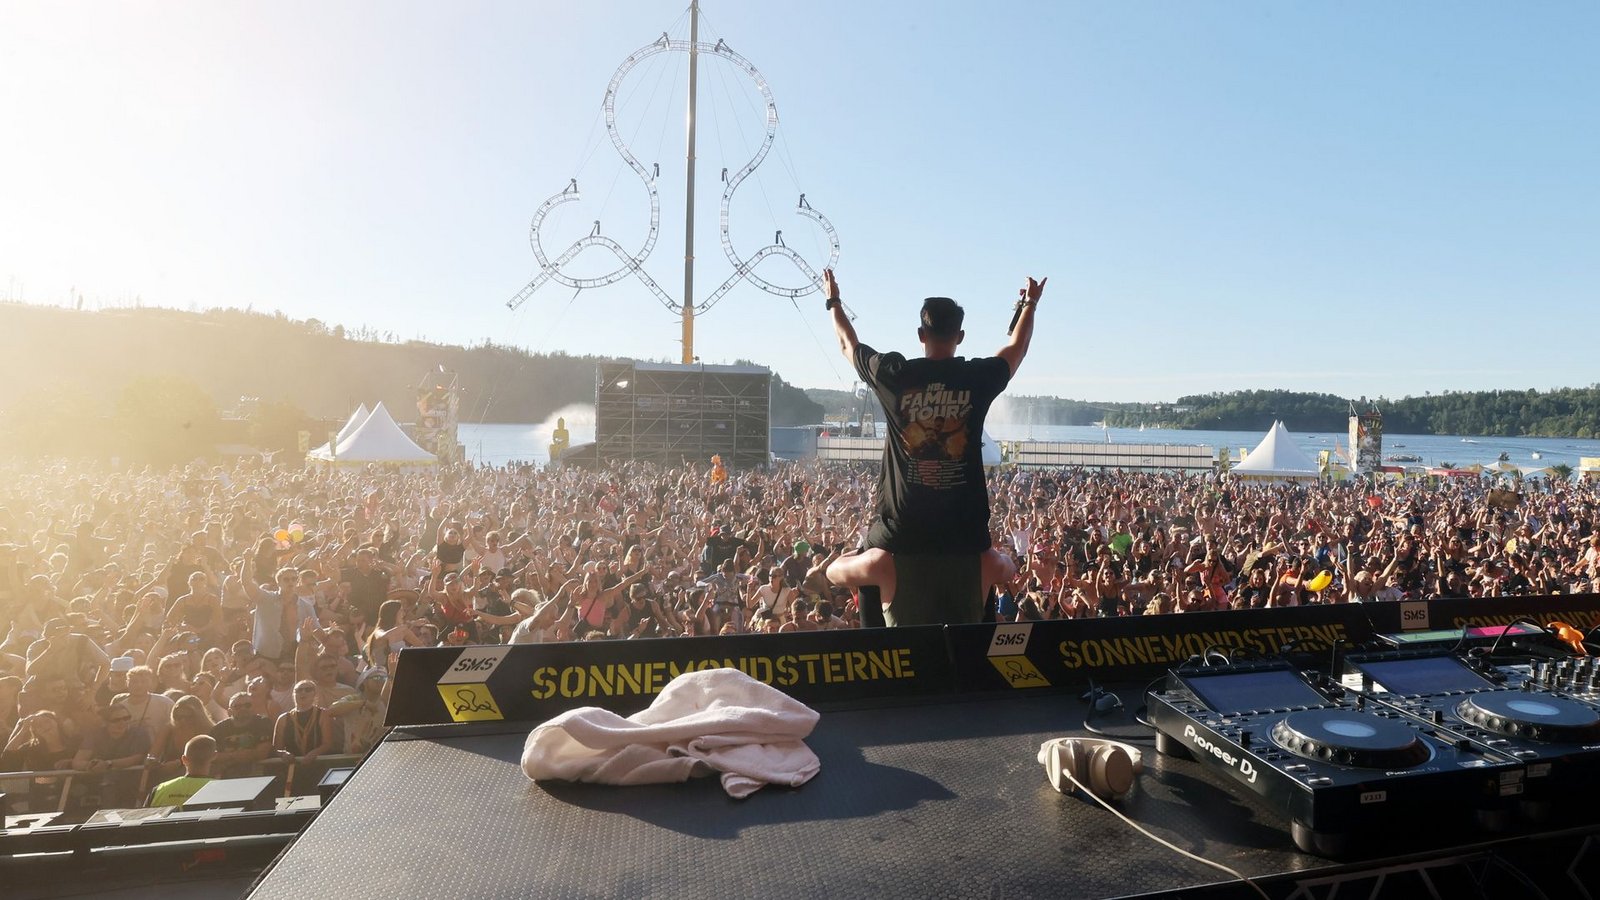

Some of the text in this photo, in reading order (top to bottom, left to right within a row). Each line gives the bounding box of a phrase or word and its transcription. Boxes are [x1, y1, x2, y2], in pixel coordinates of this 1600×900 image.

[908, 405, 959, 422] TOUR
[1403, 610, 1426, 621] SMS
[994, 633, 1026, 646] SMS
[454, 656, 497, 672] SMS
[1184, 724, 1258, 784] Pioneer DJ
